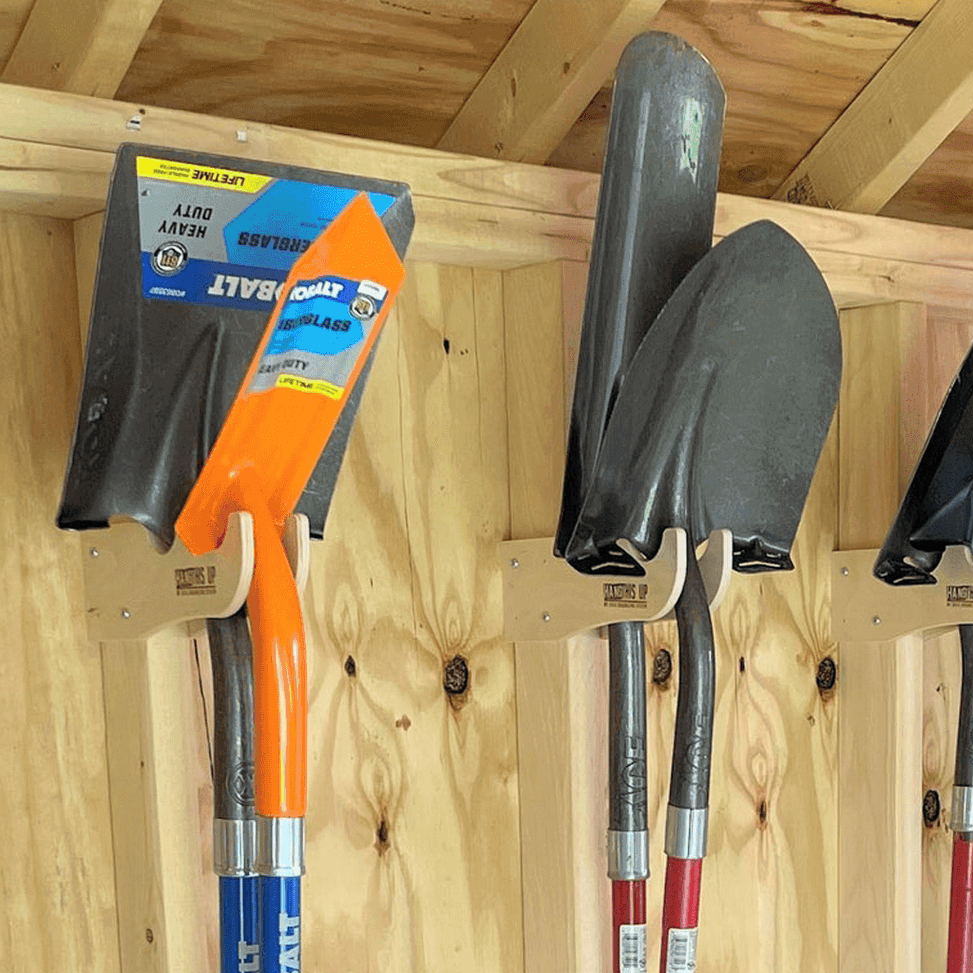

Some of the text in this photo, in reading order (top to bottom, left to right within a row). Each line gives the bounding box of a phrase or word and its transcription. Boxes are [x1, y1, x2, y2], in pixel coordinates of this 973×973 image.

[192, 169, 245, 187] LIFETIME
[172, 203, 213, 221] DUTY
[158, 219, 207, 239] HEAVY
[238, 231, 311, 253] ERGLASS
[208, 274, 287, 302] BALT
